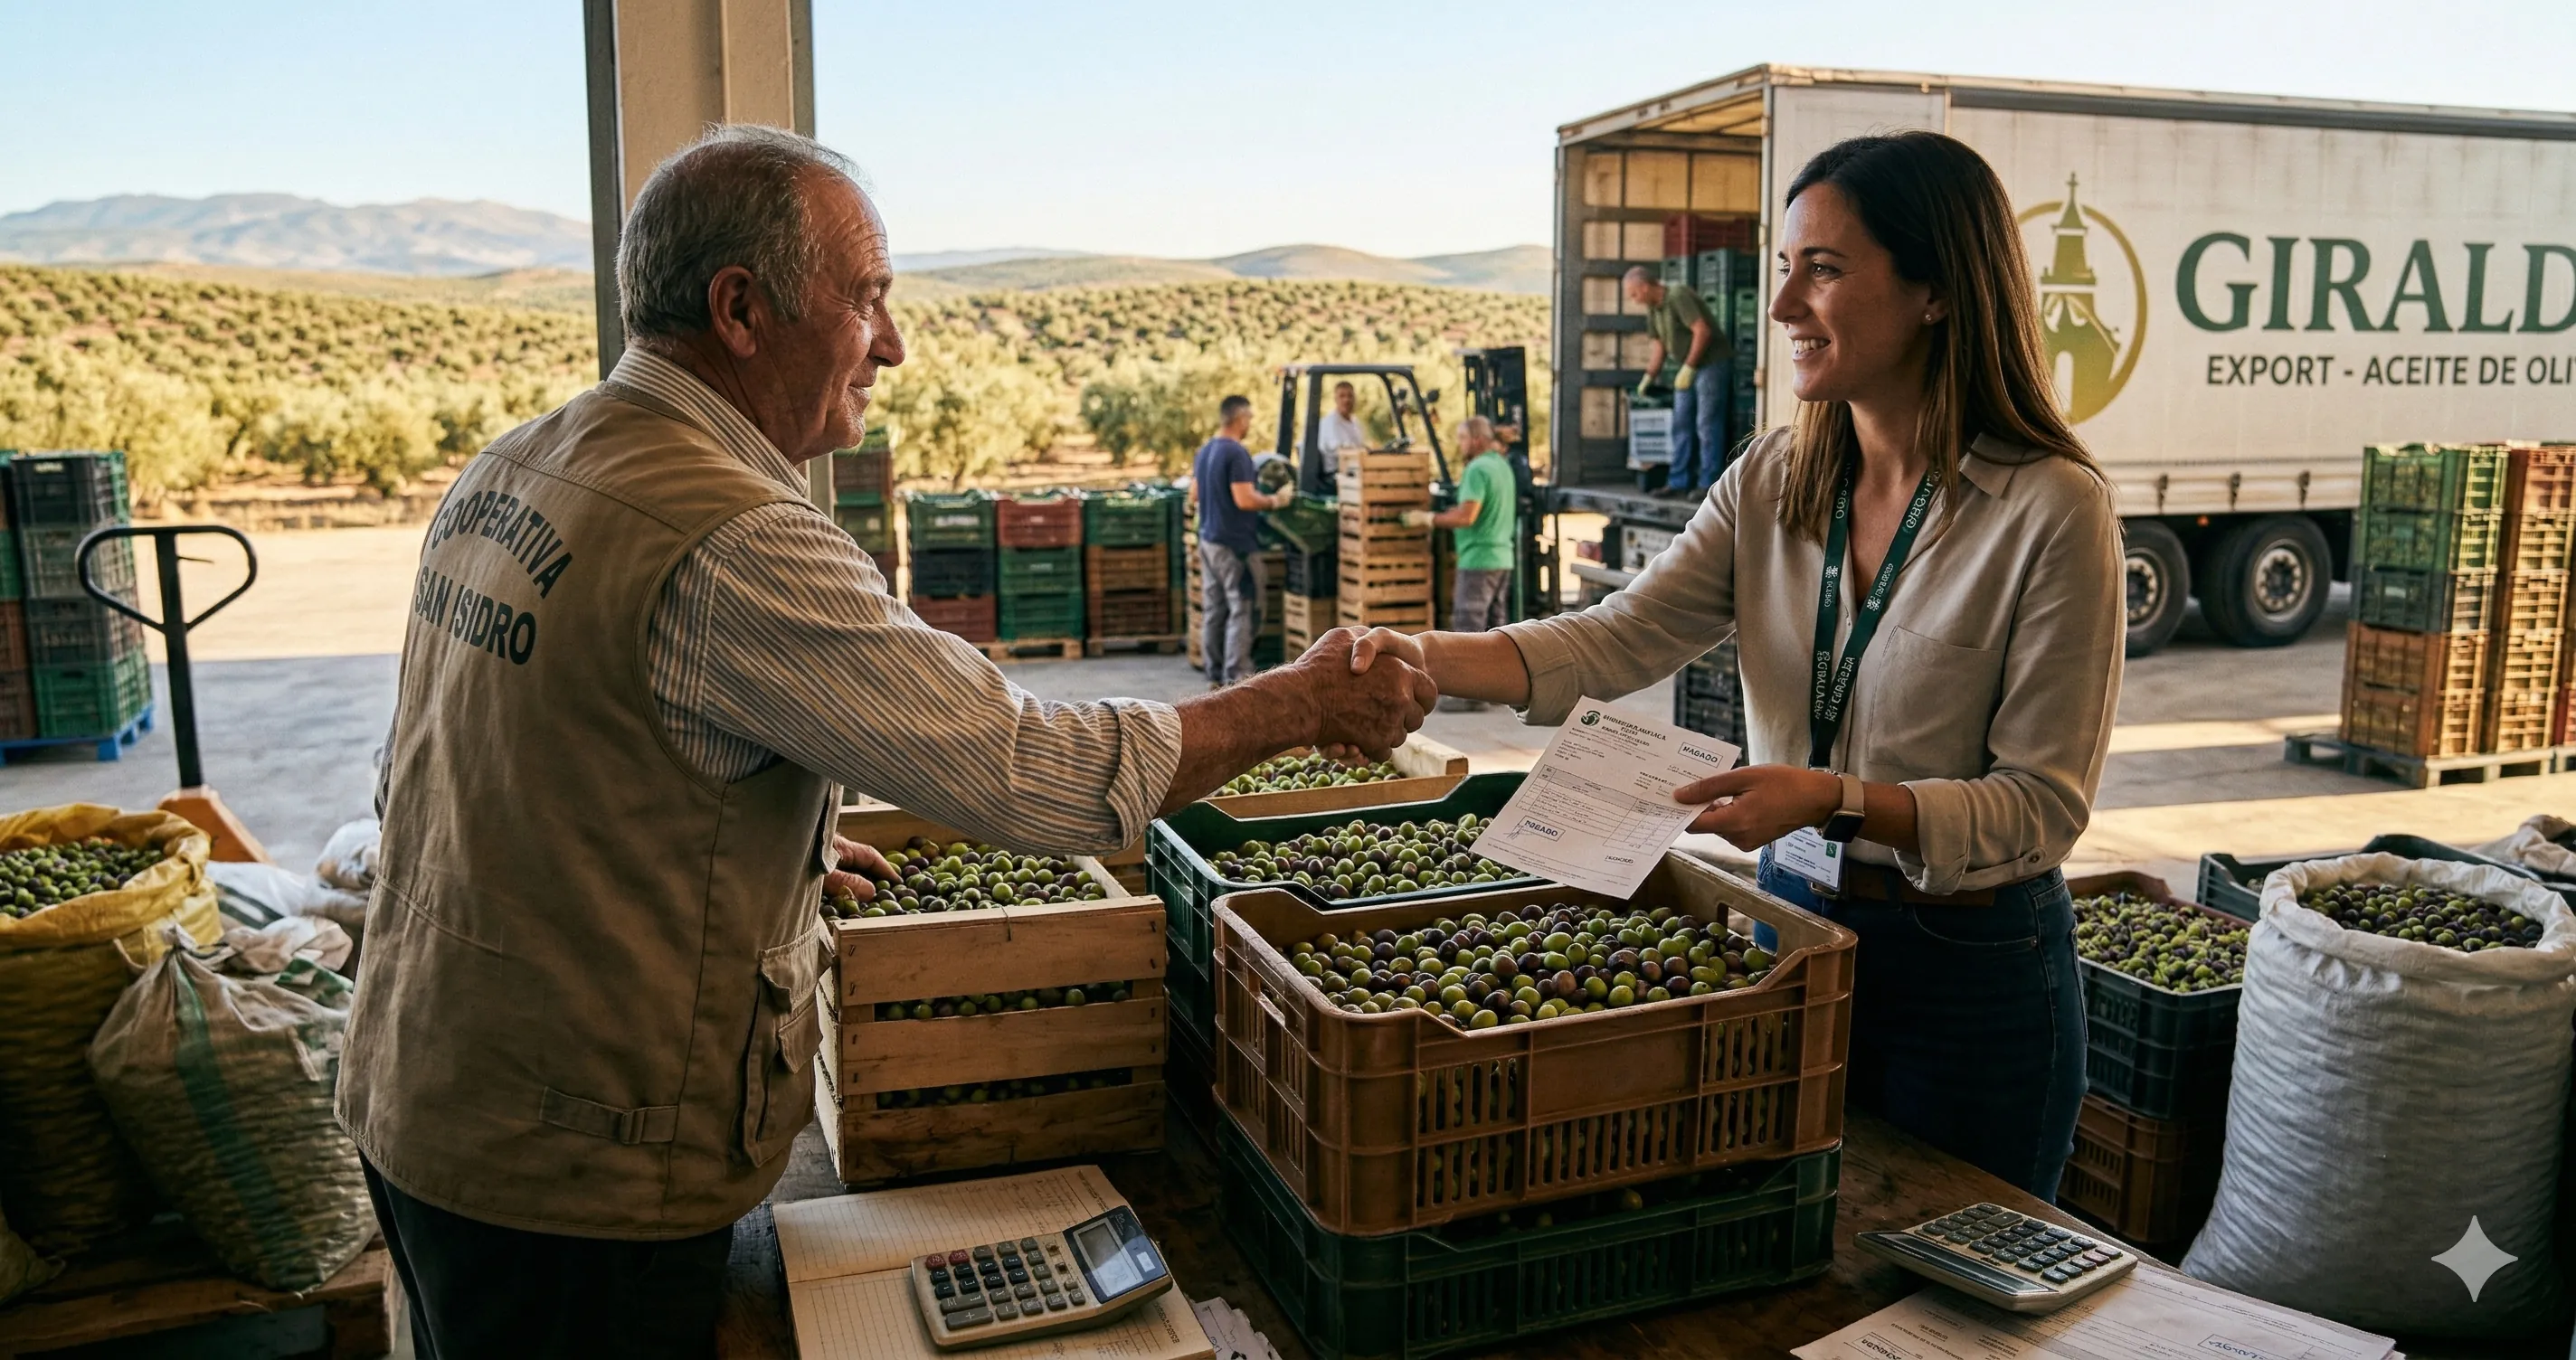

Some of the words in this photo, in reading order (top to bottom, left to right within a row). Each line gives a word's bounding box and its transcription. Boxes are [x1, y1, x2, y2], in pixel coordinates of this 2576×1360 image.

[2175, 231, 2576, 334] GIRALD
[2206, 355, 2334, 386] EXPORT
[2363, 355, 2470, 386] ACEITE
[2478, 355, 2517, 385] DE
[2526, 355, 2576, 385] OLI
[431, 490, 573, 600] COOPERATIVA
[414, 565, 453, 628] SAN
[448, 584, 536, 666] ISIDRO
